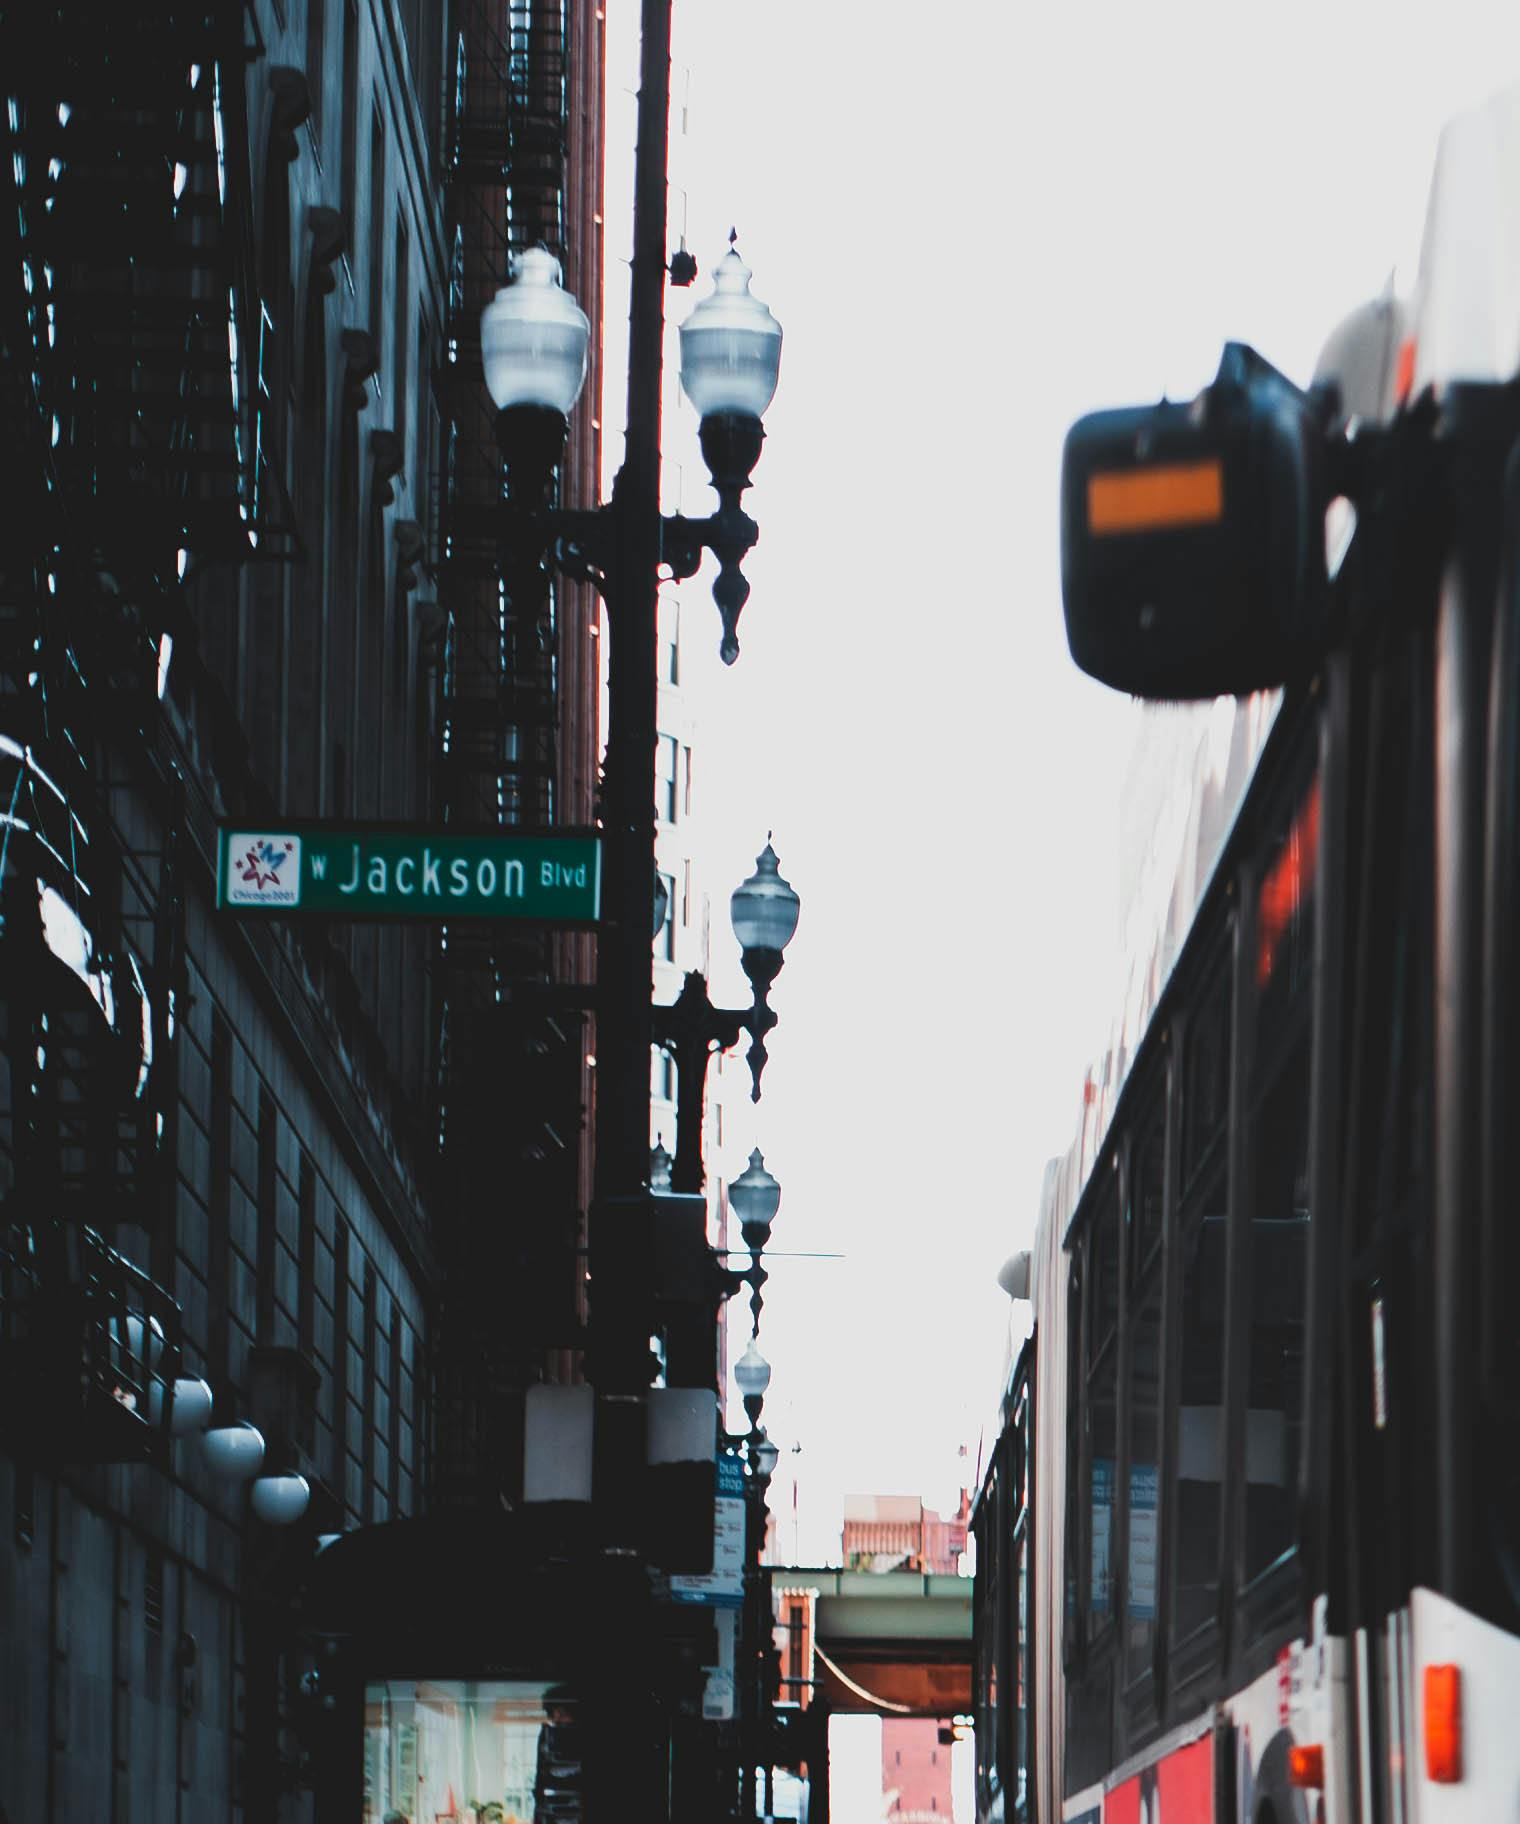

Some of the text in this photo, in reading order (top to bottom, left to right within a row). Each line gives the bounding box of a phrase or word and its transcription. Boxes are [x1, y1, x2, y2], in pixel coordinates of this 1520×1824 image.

[310, 843, 586, 898] W Jackson Blvd
[719, 1461, 739, 1475] bus
[719, 1477, 742, 1492] stop
